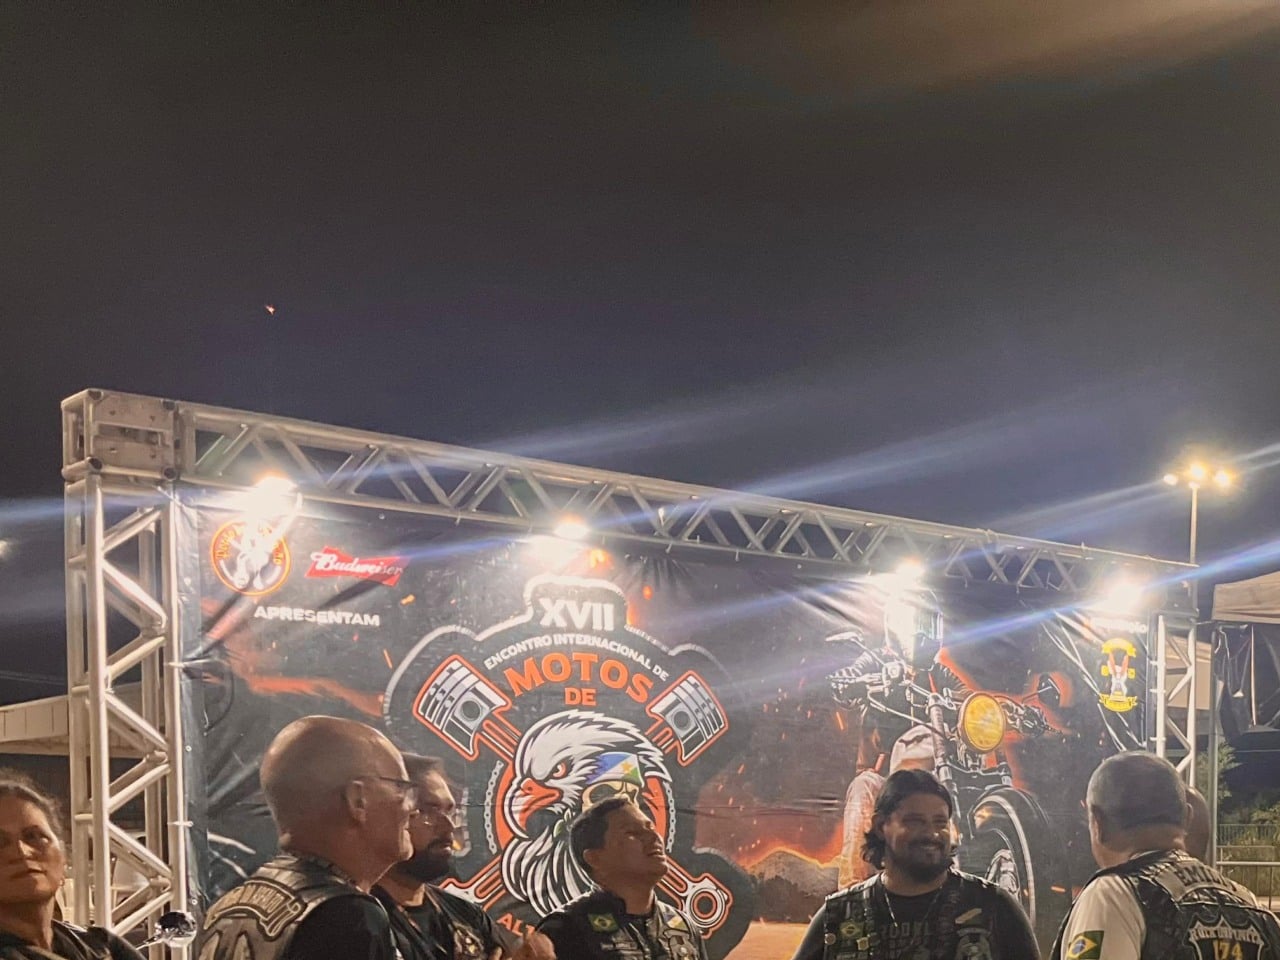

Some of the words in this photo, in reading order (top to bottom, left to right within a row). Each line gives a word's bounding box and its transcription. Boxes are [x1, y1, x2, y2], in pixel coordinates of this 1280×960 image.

[310, 552, 403, 574] Budweiser
[254, 606, 380, 627] APRESENTAM
[539, 598, 614, 632] XVII
[484, 634, 552, 670] ENCONTRO
[554, 634, 651, 669] INTERNACIONAL
[653, 664, 670, 682] DE
[504, 652, 653, 704] MOTOS
[564, 687, 597, 706] DE
